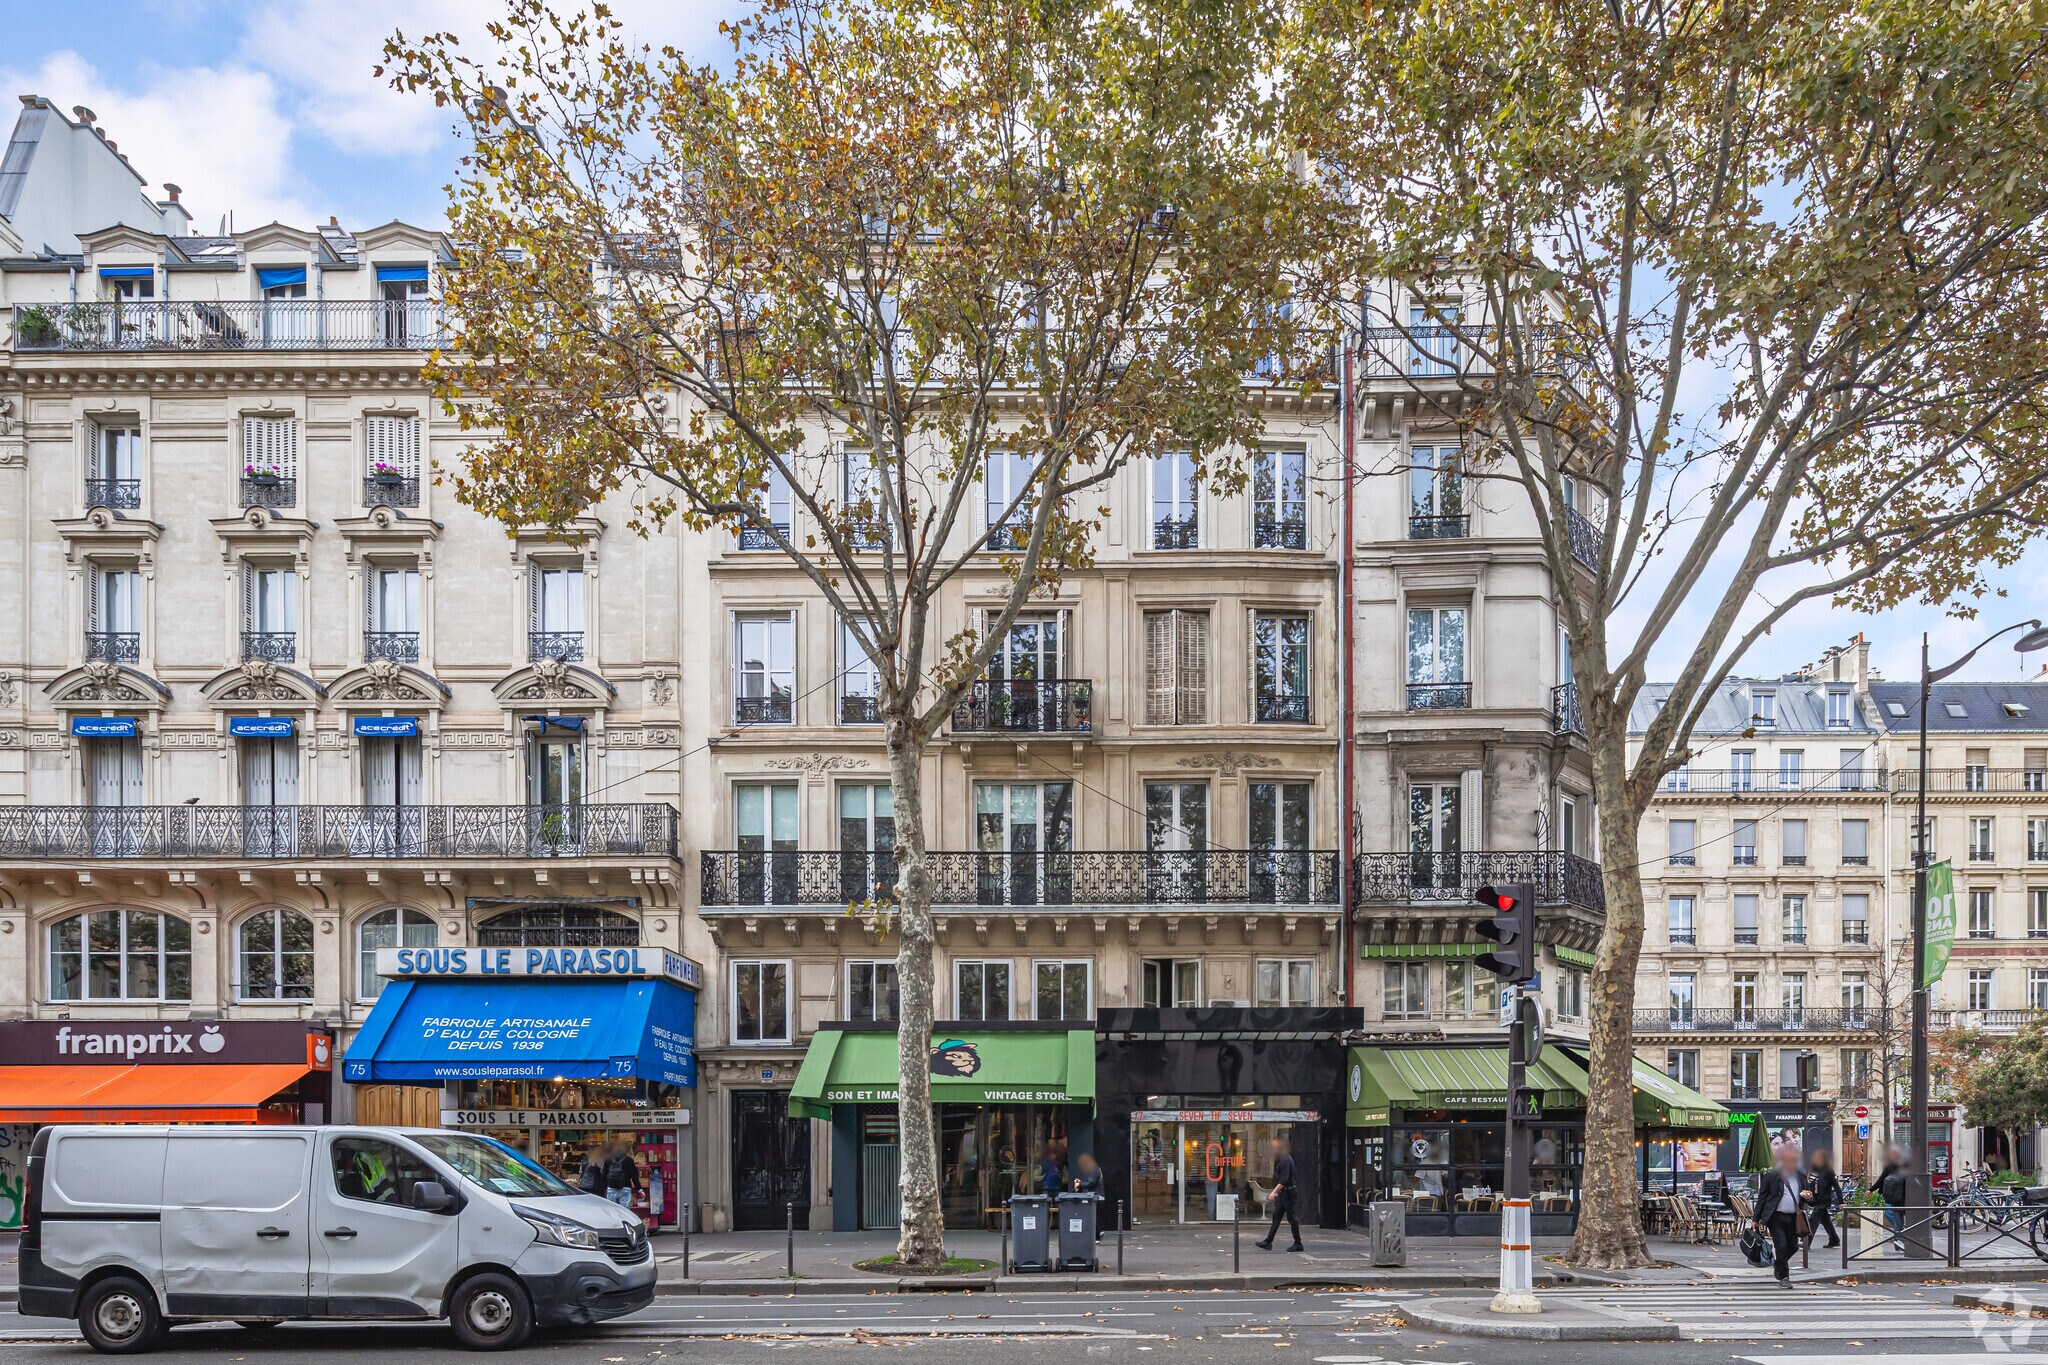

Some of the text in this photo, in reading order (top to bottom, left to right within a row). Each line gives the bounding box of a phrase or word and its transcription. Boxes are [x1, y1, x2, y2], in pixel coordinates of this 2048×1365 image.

[397, 948, 646, 974] SOUS LE PARASOL
[665, 953, 700, 985] PARFUMERIE
[421, 1017, 592, 1028] FABRIQUE ARTISANALE
[478, 1030, 499, 1039] DE
[506, 1029, 580, 1039] COLOGNE
[651, 1025, 671, 1040] FABRIQUE
[55, 1025, 194, 1060] franprix
[448, 1040, 544, 1050] DEPUIS 1936
[663, 1051, 678, 1064] DEPUIS
[350, 1064, 366, 1076] 75
[434, 1065, 545, 1078] www.sousleparasol.fr
[615, 1060, 632, 1073] 75
[663, 1071, 689, 1085] PARFUMERIE
[827, 1090, 900, 1100] SON ET IMA
[984, 1091, 1072, 1100] VINTAGE STOR
[457, 1111, 608, 1124] SOUS LE PARASOL
[1179, 1110, 1204, 1121] SEVEN
[1228, 1110, 1253, 1121] SEVEN
[1728, 1113, 1758, 1123] VANC
